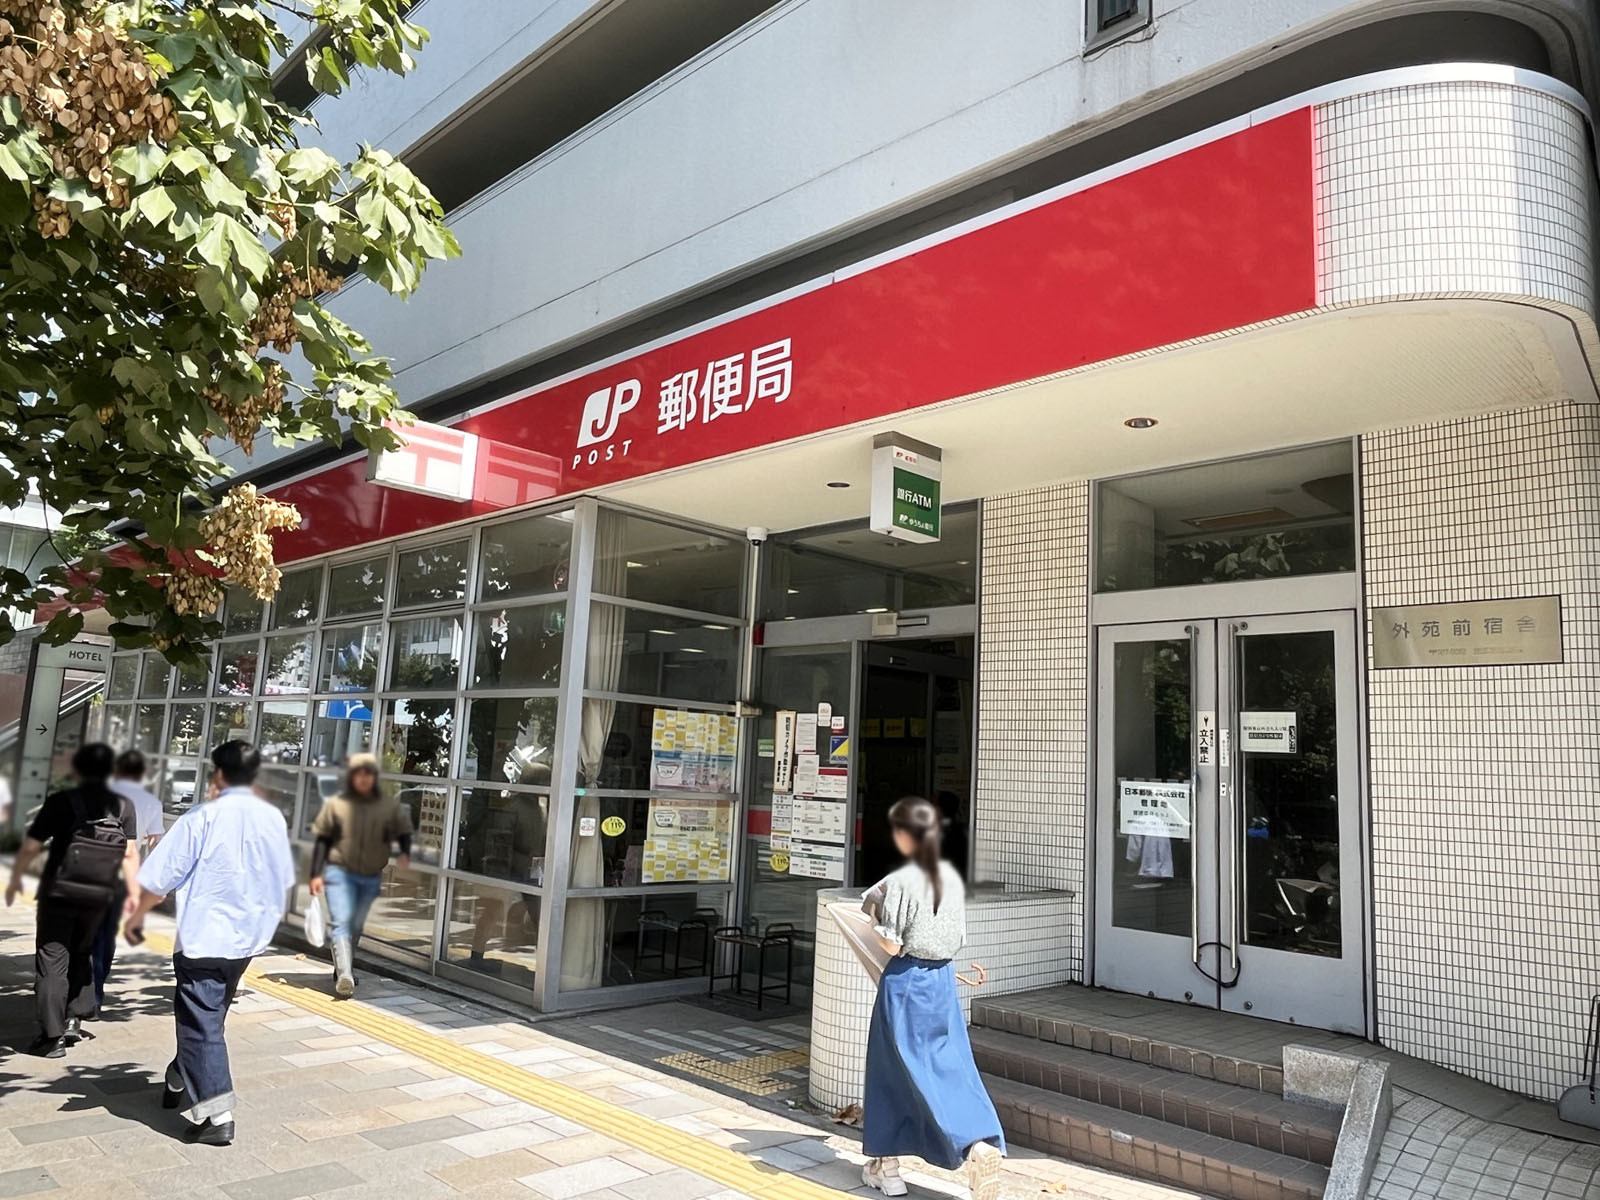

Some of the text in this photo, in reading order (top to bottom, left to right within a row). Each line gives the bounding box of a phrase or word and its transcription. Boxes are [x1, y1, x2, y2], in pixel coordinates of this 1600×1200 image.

[657, 338, 793, 435] 郵便局
[577, 379, 641, 448] JP
[572, 440, 632, 469] POST
[1391, 615, 1537, 639] 外苑前宿舎
[69, 650, 103, 662] HOTEL
[1199, 729, 1210, 763] 立入禁止
